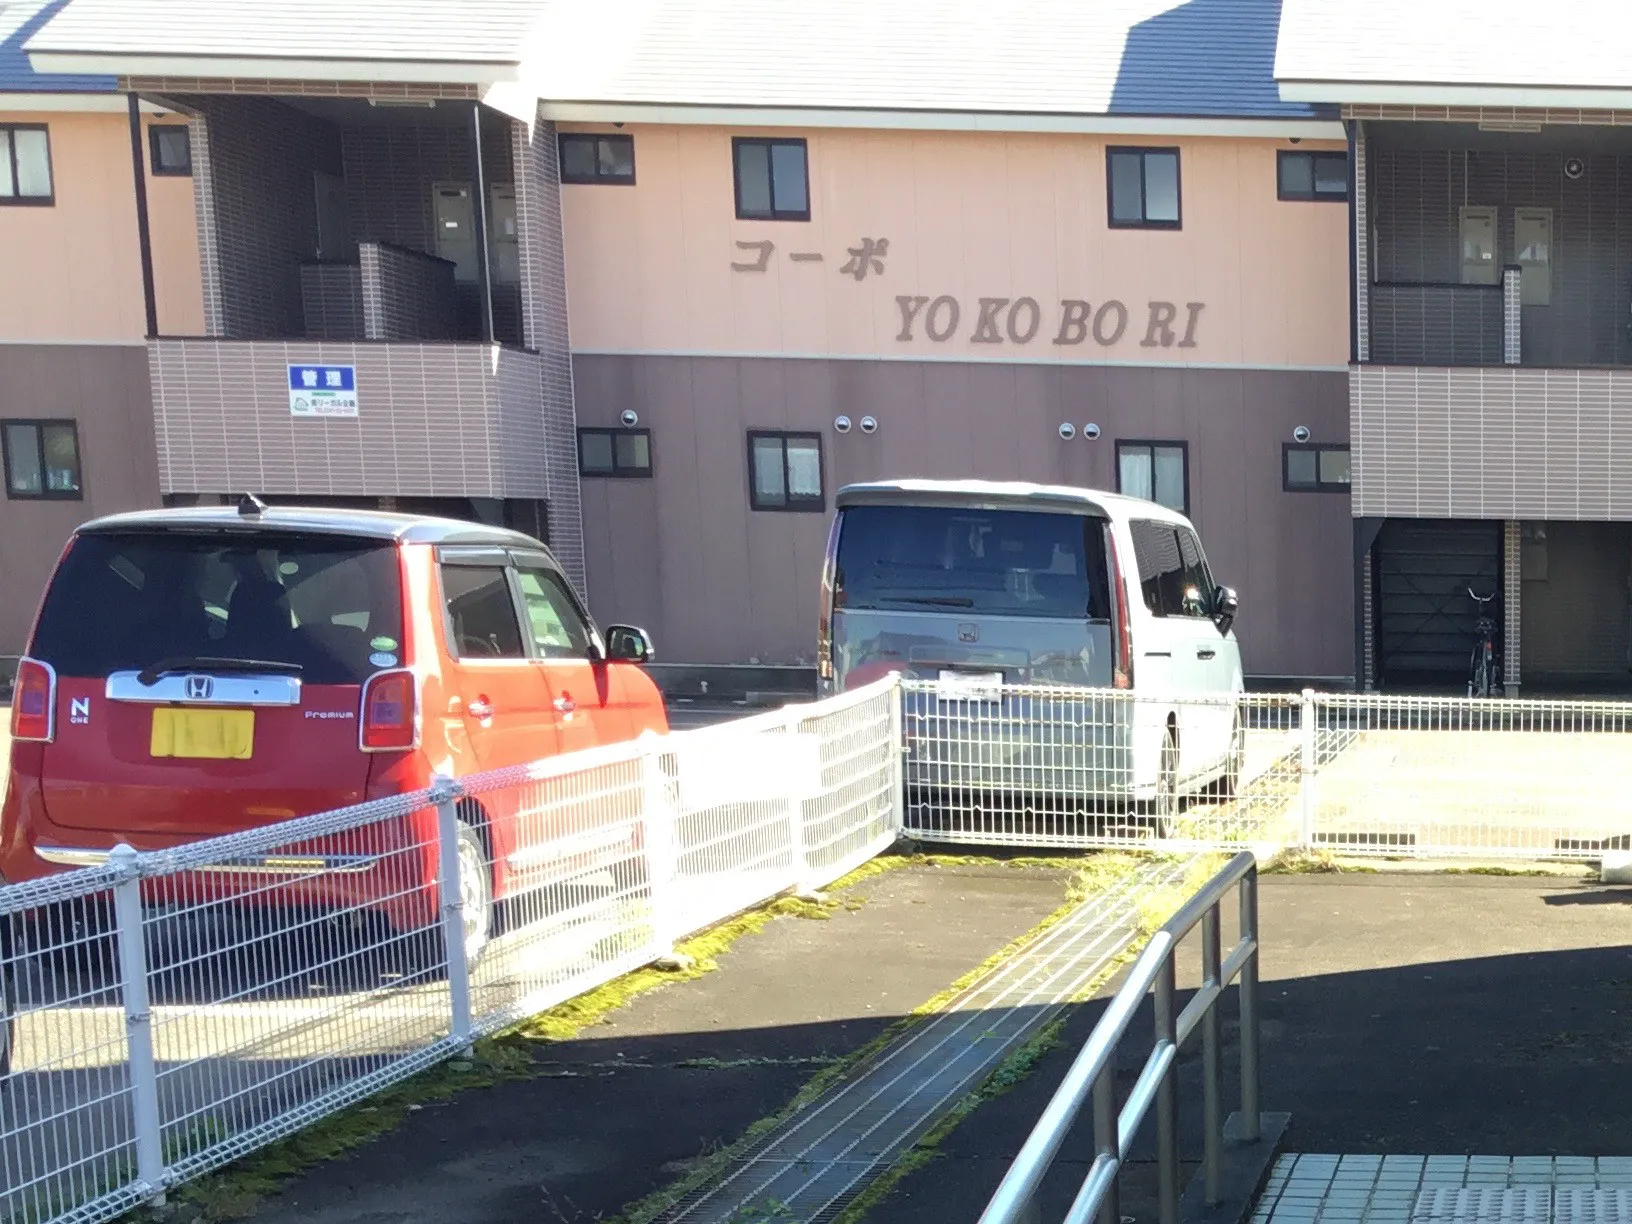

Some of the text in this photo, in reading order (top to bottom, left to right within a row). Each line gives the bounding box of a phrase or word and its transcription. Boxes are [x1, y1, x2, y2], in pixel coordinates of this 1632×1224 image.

[730, 236, 890, 282] コーポ
[71, 697, 90, 716] N
[70, 716, 89, 724] ONE
[305, 711, 354, 719] Premium
